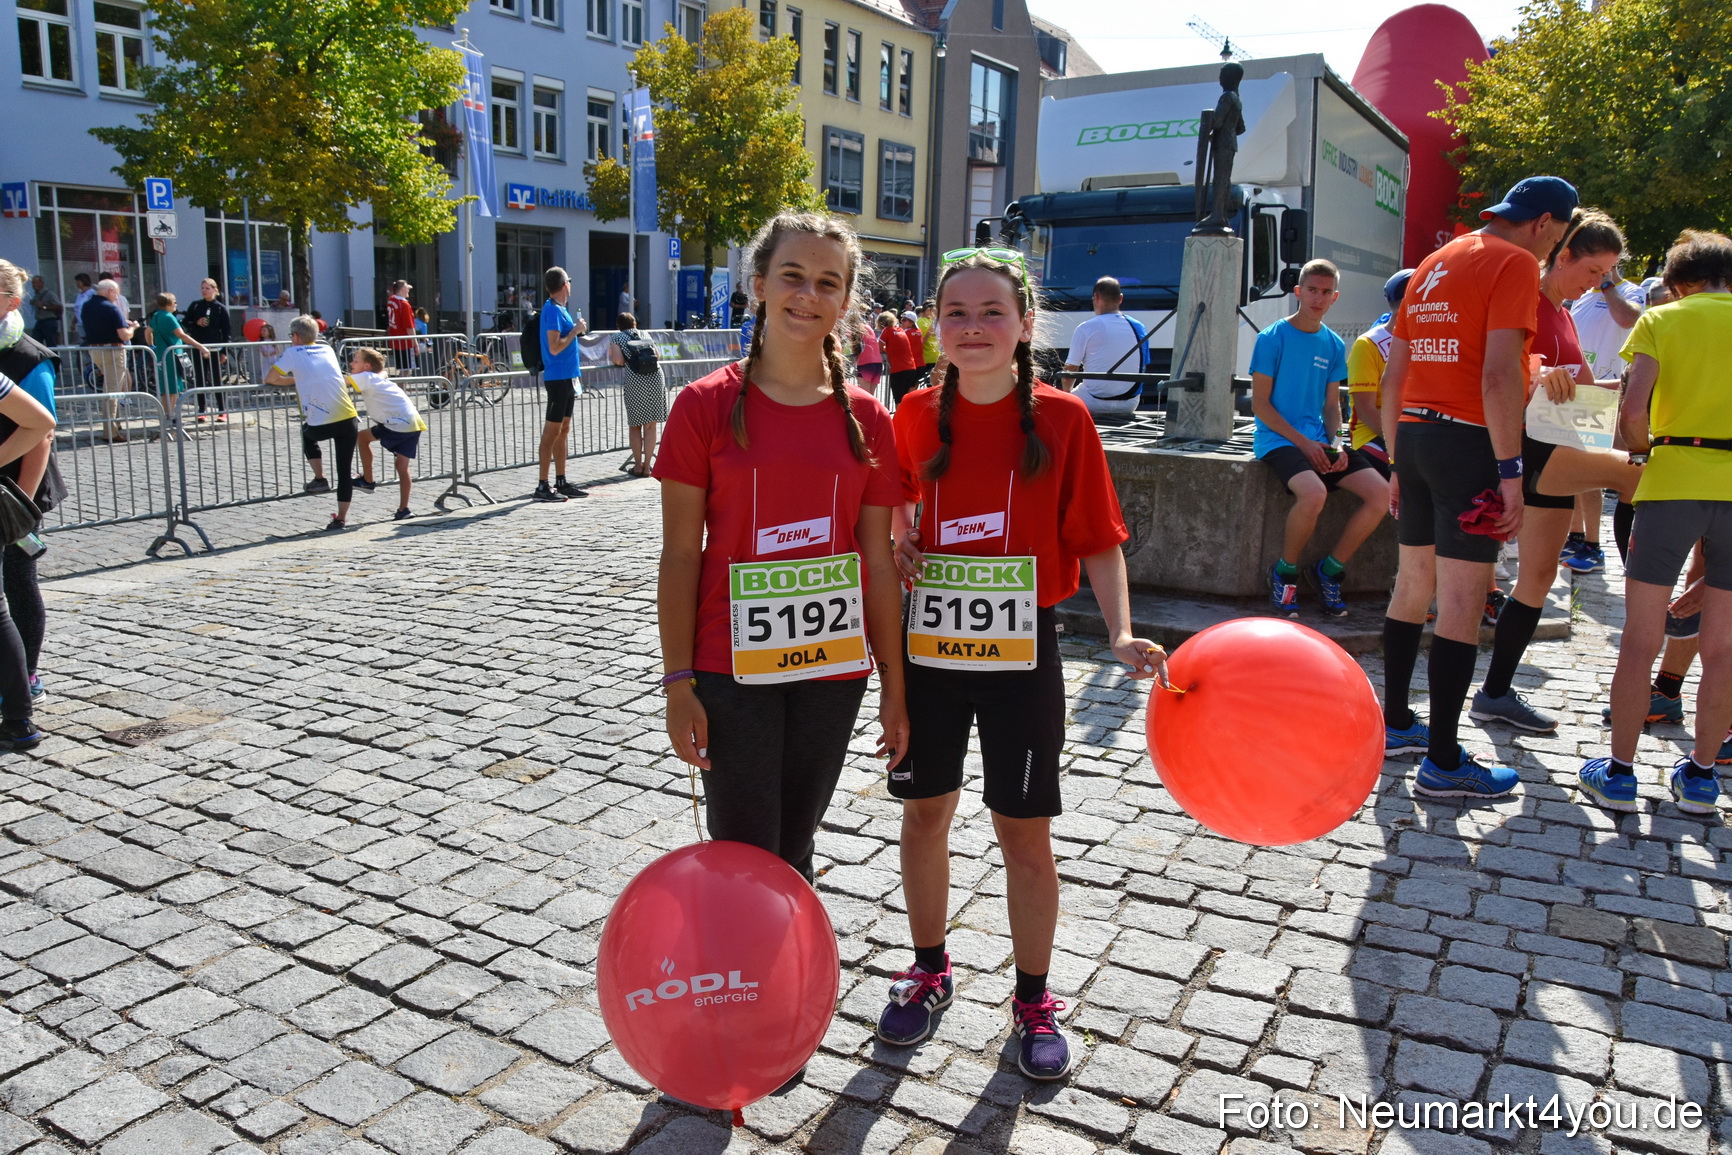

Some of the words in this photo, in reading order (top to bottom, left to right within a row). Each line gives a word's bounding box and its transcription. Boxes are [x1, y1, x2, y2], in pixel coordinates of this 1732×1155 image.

[1077, 119, 1200, 146] BOCK
[1322, 138, 1338, 168] OFFICE
[152, 182, 167, 206] P
[1376, 168, 1400, 213] BOCK
[670, 240, 678, 256] P
[1416, 311, 1458, 323] neumarkt
[777, 527, 811, 544] DEHN
[957, 521, 986, 536] DEHN
[742, 561, 848, 593] BOCK
[923, 560, 1019, 586] BOCK
[922, 594, 1016, 632] 5191
[1024, 600, 1031, 608] S
[748, 597, 849, 642] 5192
[777, 648, 828, 668] JOLA
[937, 641, 1000, 657] KATJA
